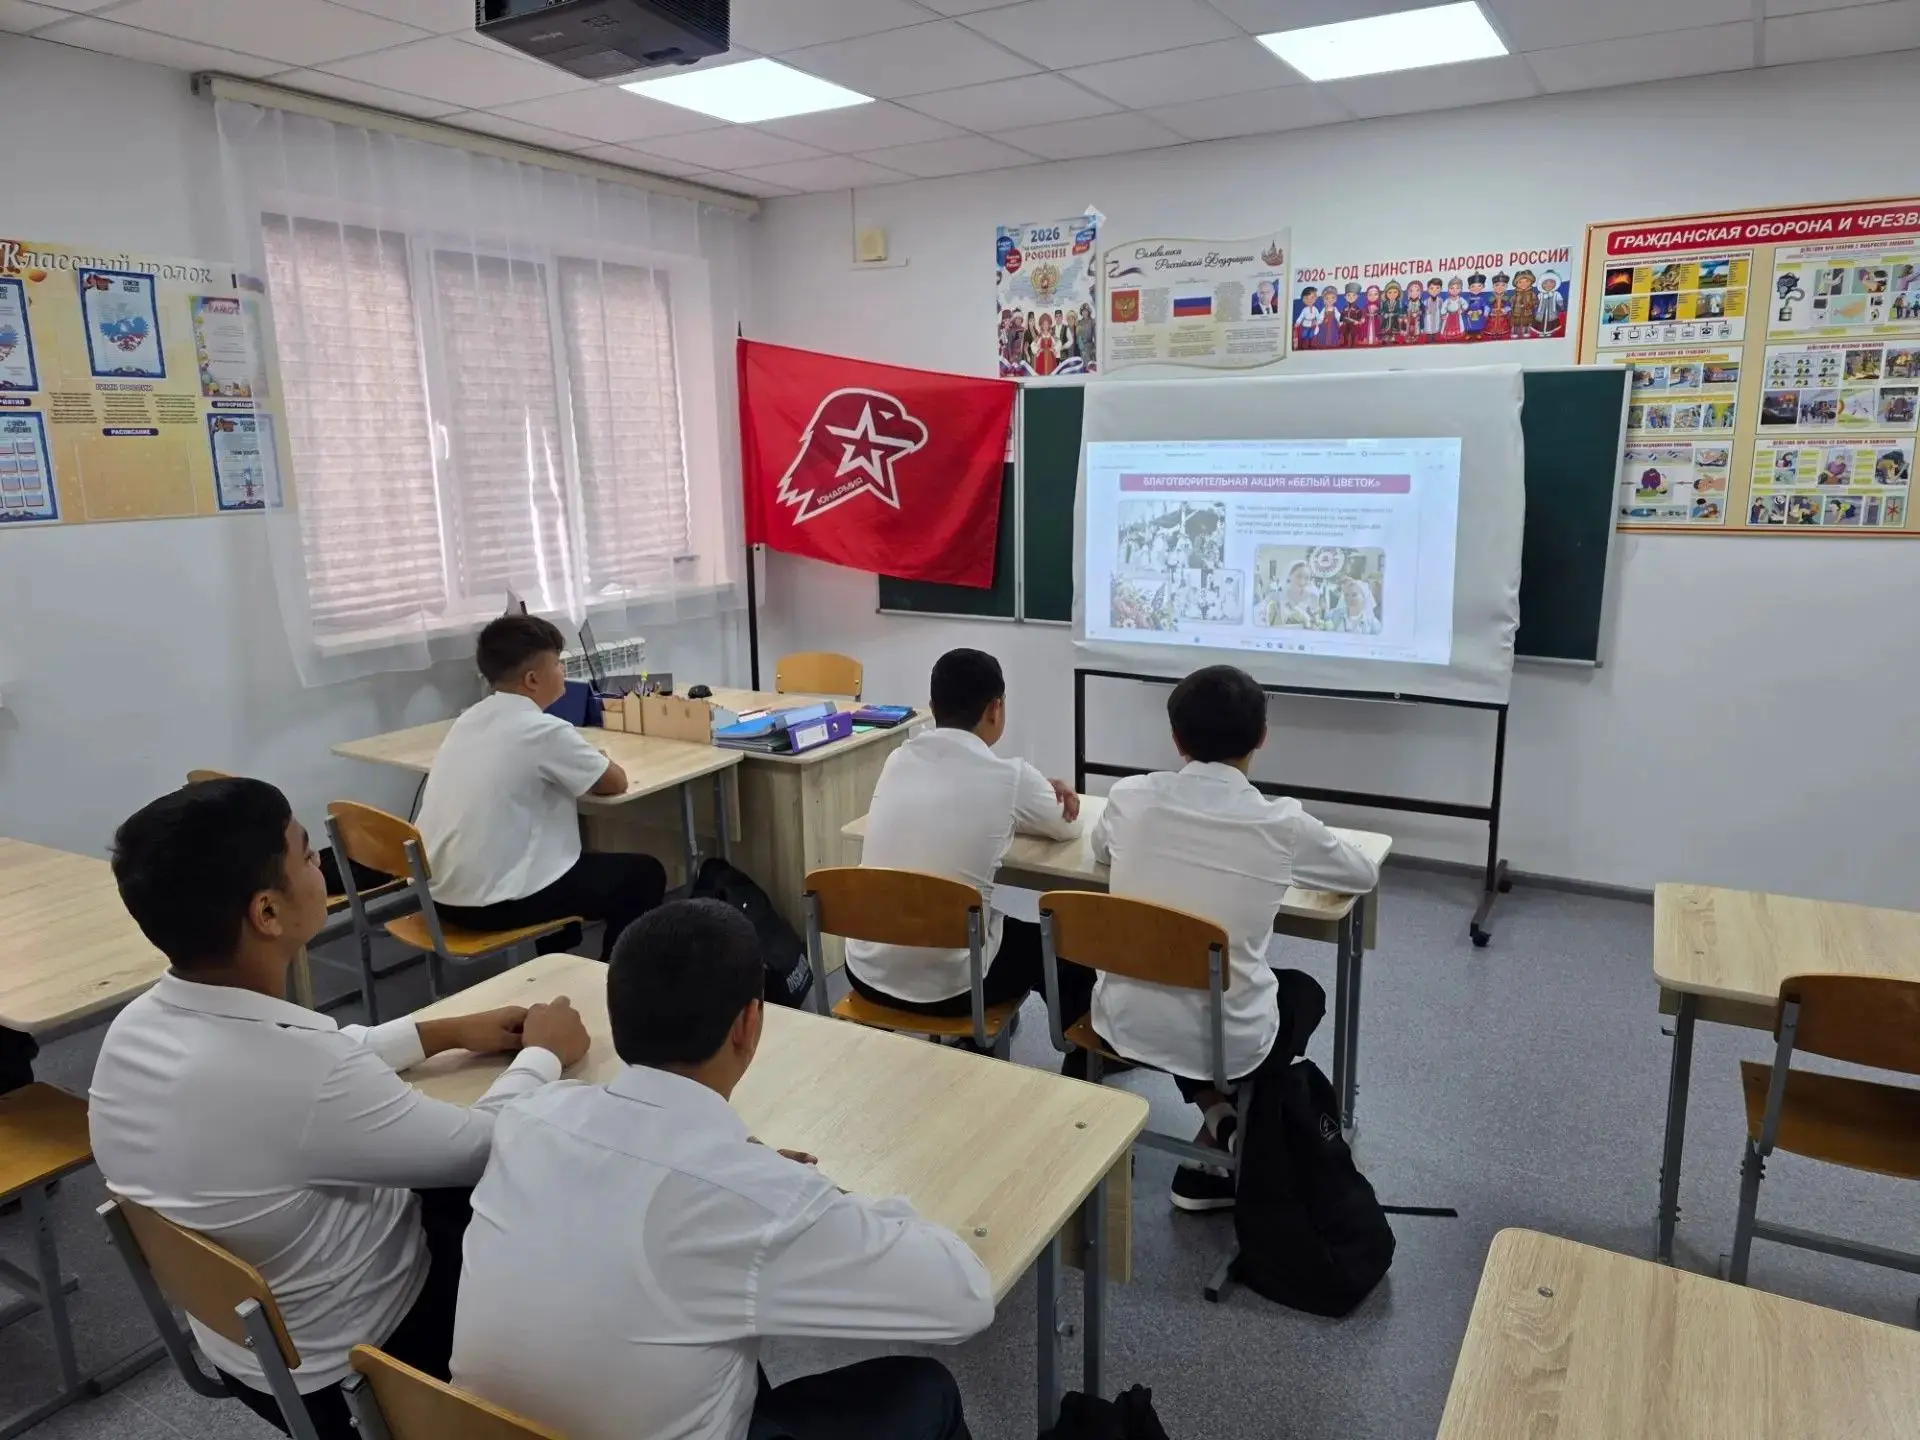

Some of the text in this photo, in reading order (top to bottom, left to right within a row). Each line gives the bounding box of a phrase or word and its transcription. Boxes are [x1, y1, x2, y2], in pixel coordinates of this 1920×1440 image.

[1031, 227, 1060, 243] 2026
[1614, 211, 1920, 249] ГРАЖДАНСКАЯ ОБОРОНА И ЧРЕЗВ
[1297, 248, 1569, 283] 2026-ГОД ЕДИНСТВА НАРОДОВ РОССИИ
[817, 477, 863, 505] ЮНАРМИЯ
[1143, 476, 1249, 487] БЛАГОТВОРИТЕЛЬНАЯ
[1250, 477, 1285, 488] АКЦИЯ
[1287, 475, 1331, 488] «БЕЛЫЙ
